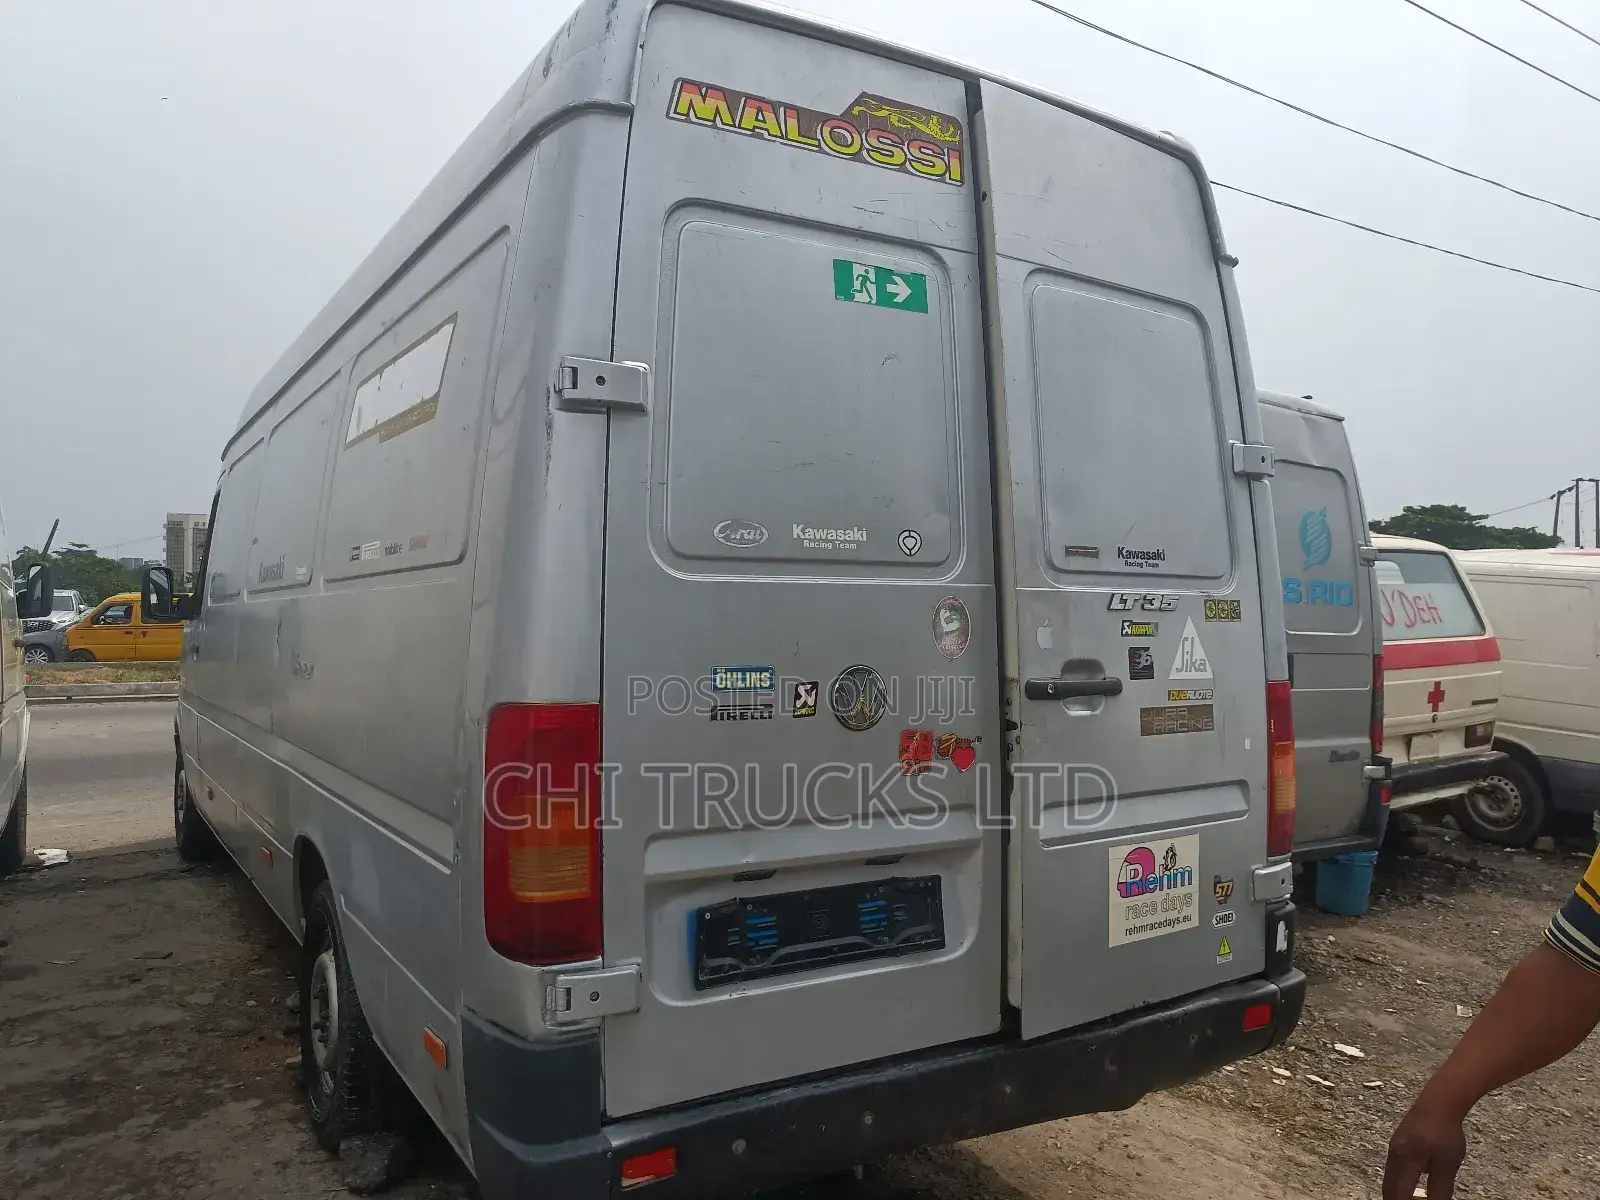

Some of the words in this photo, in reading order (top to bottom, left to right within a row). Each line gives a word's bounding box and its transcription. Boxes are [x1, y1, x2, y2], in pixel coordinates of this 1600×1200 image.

[670, 80, 963, 187] MALOSSI
[792, 523, 867, 542] Kawasaki
[803, 540, 833, 550] Racing
[835, 541, 857, 550] Team
[1117, 546, 1166, 561] Kawasaki
[1124, 560, 1144, 569] Racing
[1107, 593, 1140, 611] LT
[1141, 593, 1180, 611] 35
[1175, 636, 1208, 673] Sika
[715, 669, 771, 689] ÖHLINS
[709, 703, 774, 721] PIRELLI
[1125, 862, 1193, 898] Rehm
[1125, 900, 1158, 920] race
[1161, 892, 1193, 914] days
[1125, 914, 1192, 937] rehmracedays.eu
